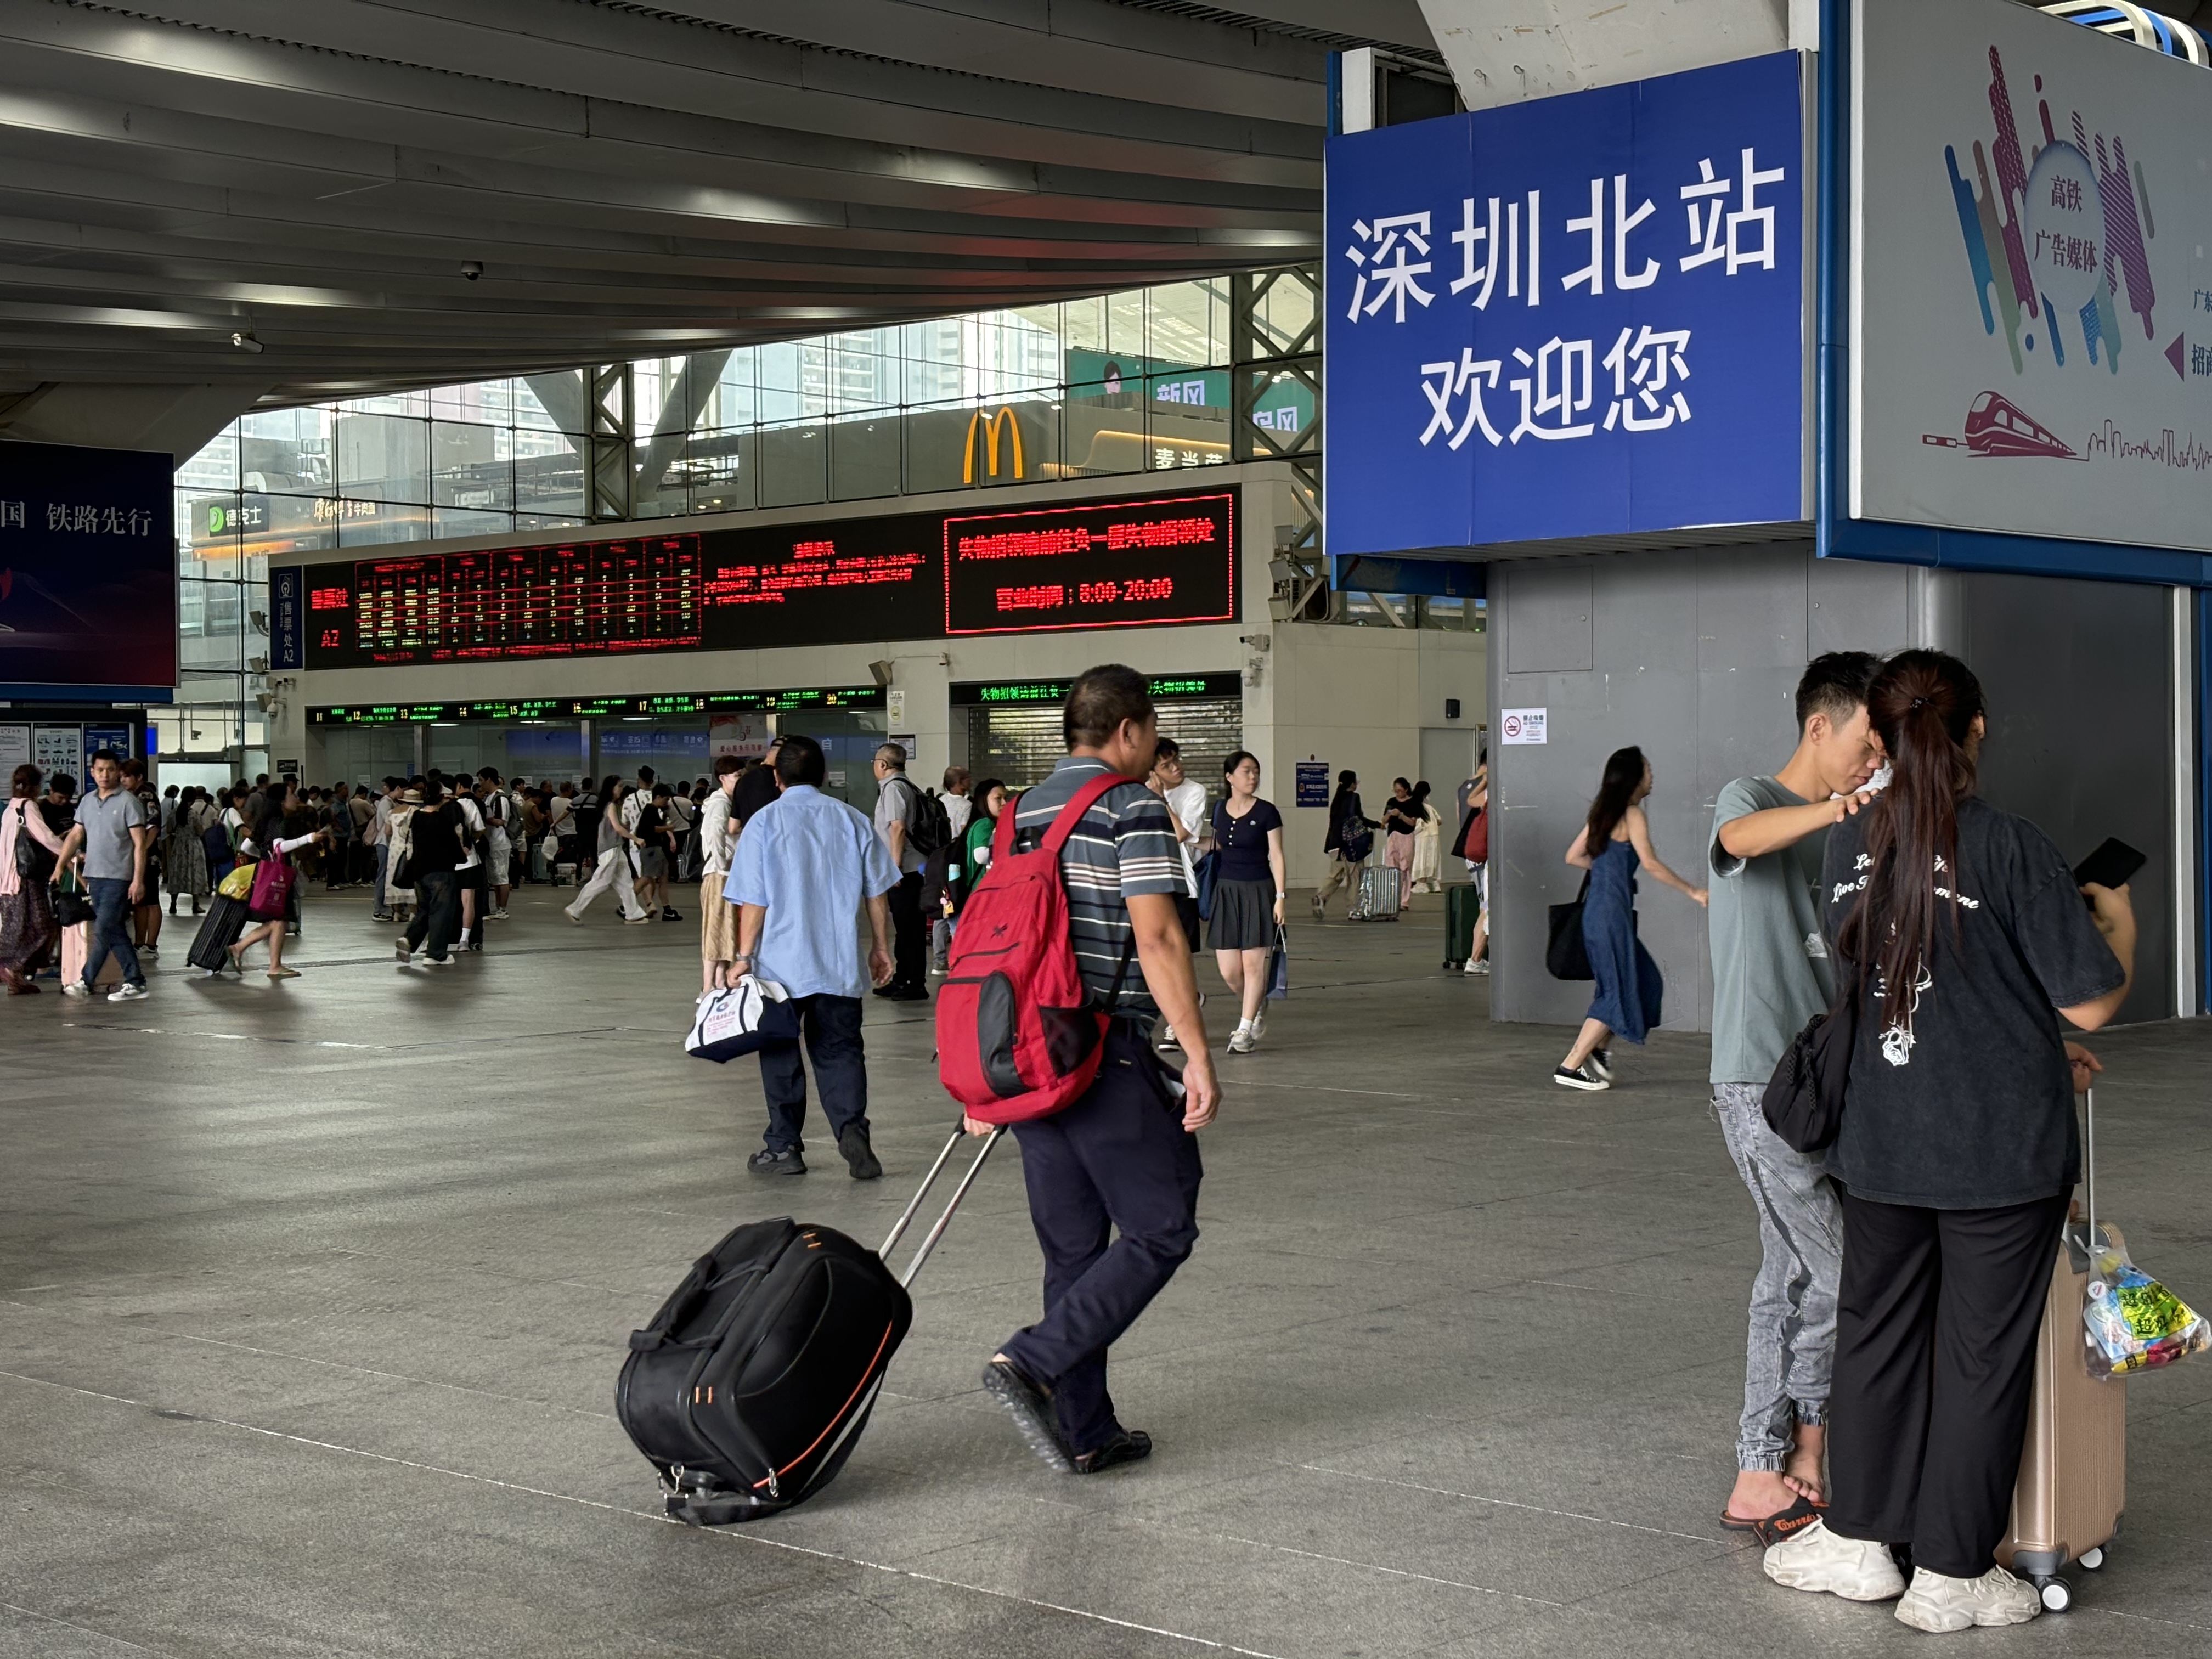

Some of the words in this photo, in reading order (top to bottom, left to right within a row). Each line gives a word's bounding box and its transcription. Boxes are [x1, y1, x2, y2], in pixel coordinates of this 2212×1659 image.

[2050, 174, 2083, 213] 高铁
[1345, 148, 1785, 323] 深圳北站
[2034, 229, 2098, 274] 广告媒体
[1419, 325, 1691, 451] 欢迎您
[1, 500, 25, 528] 国
[46, 503, 153, 536] 铁路先行
[226, 505, 262, 527] 德克士
[284, 601, 292, 647] 售票处
[321, 630, 339, 647] A2
[283, 649, 294, 662] A2
[353, 711, 360, 720] 12
[510, 706, 517, 715] 15
[639, 701, 647, 711] 17
